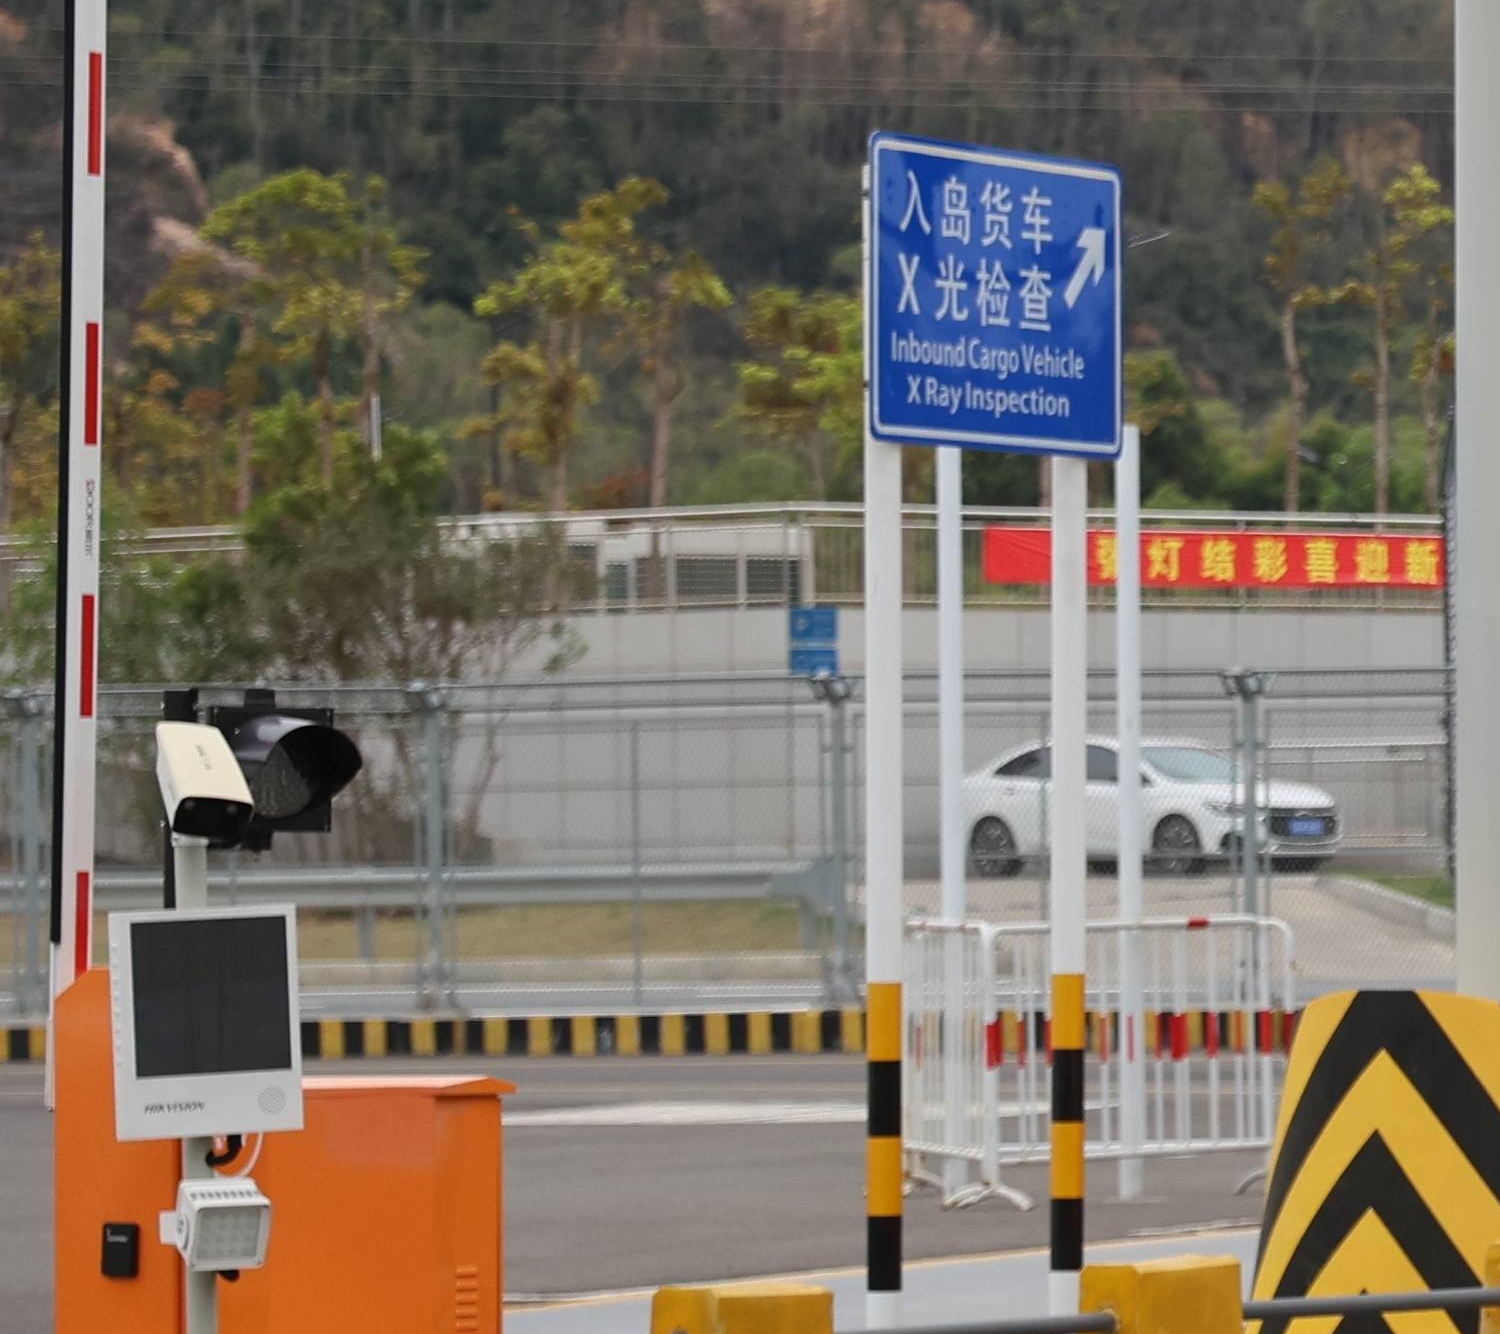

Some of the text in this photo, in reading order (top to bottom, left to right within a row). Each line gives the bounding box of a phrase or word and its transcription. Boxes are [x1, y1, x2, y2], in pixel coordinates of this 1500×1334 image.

[899, 169, 1054, 255] 入岛货车
[898, 253, 1054, 332] X光检查
[891, 331, 1086, 381] Inbound Cargo Vehicle
[907, 374, 1071, 419] X Ray Inspection
